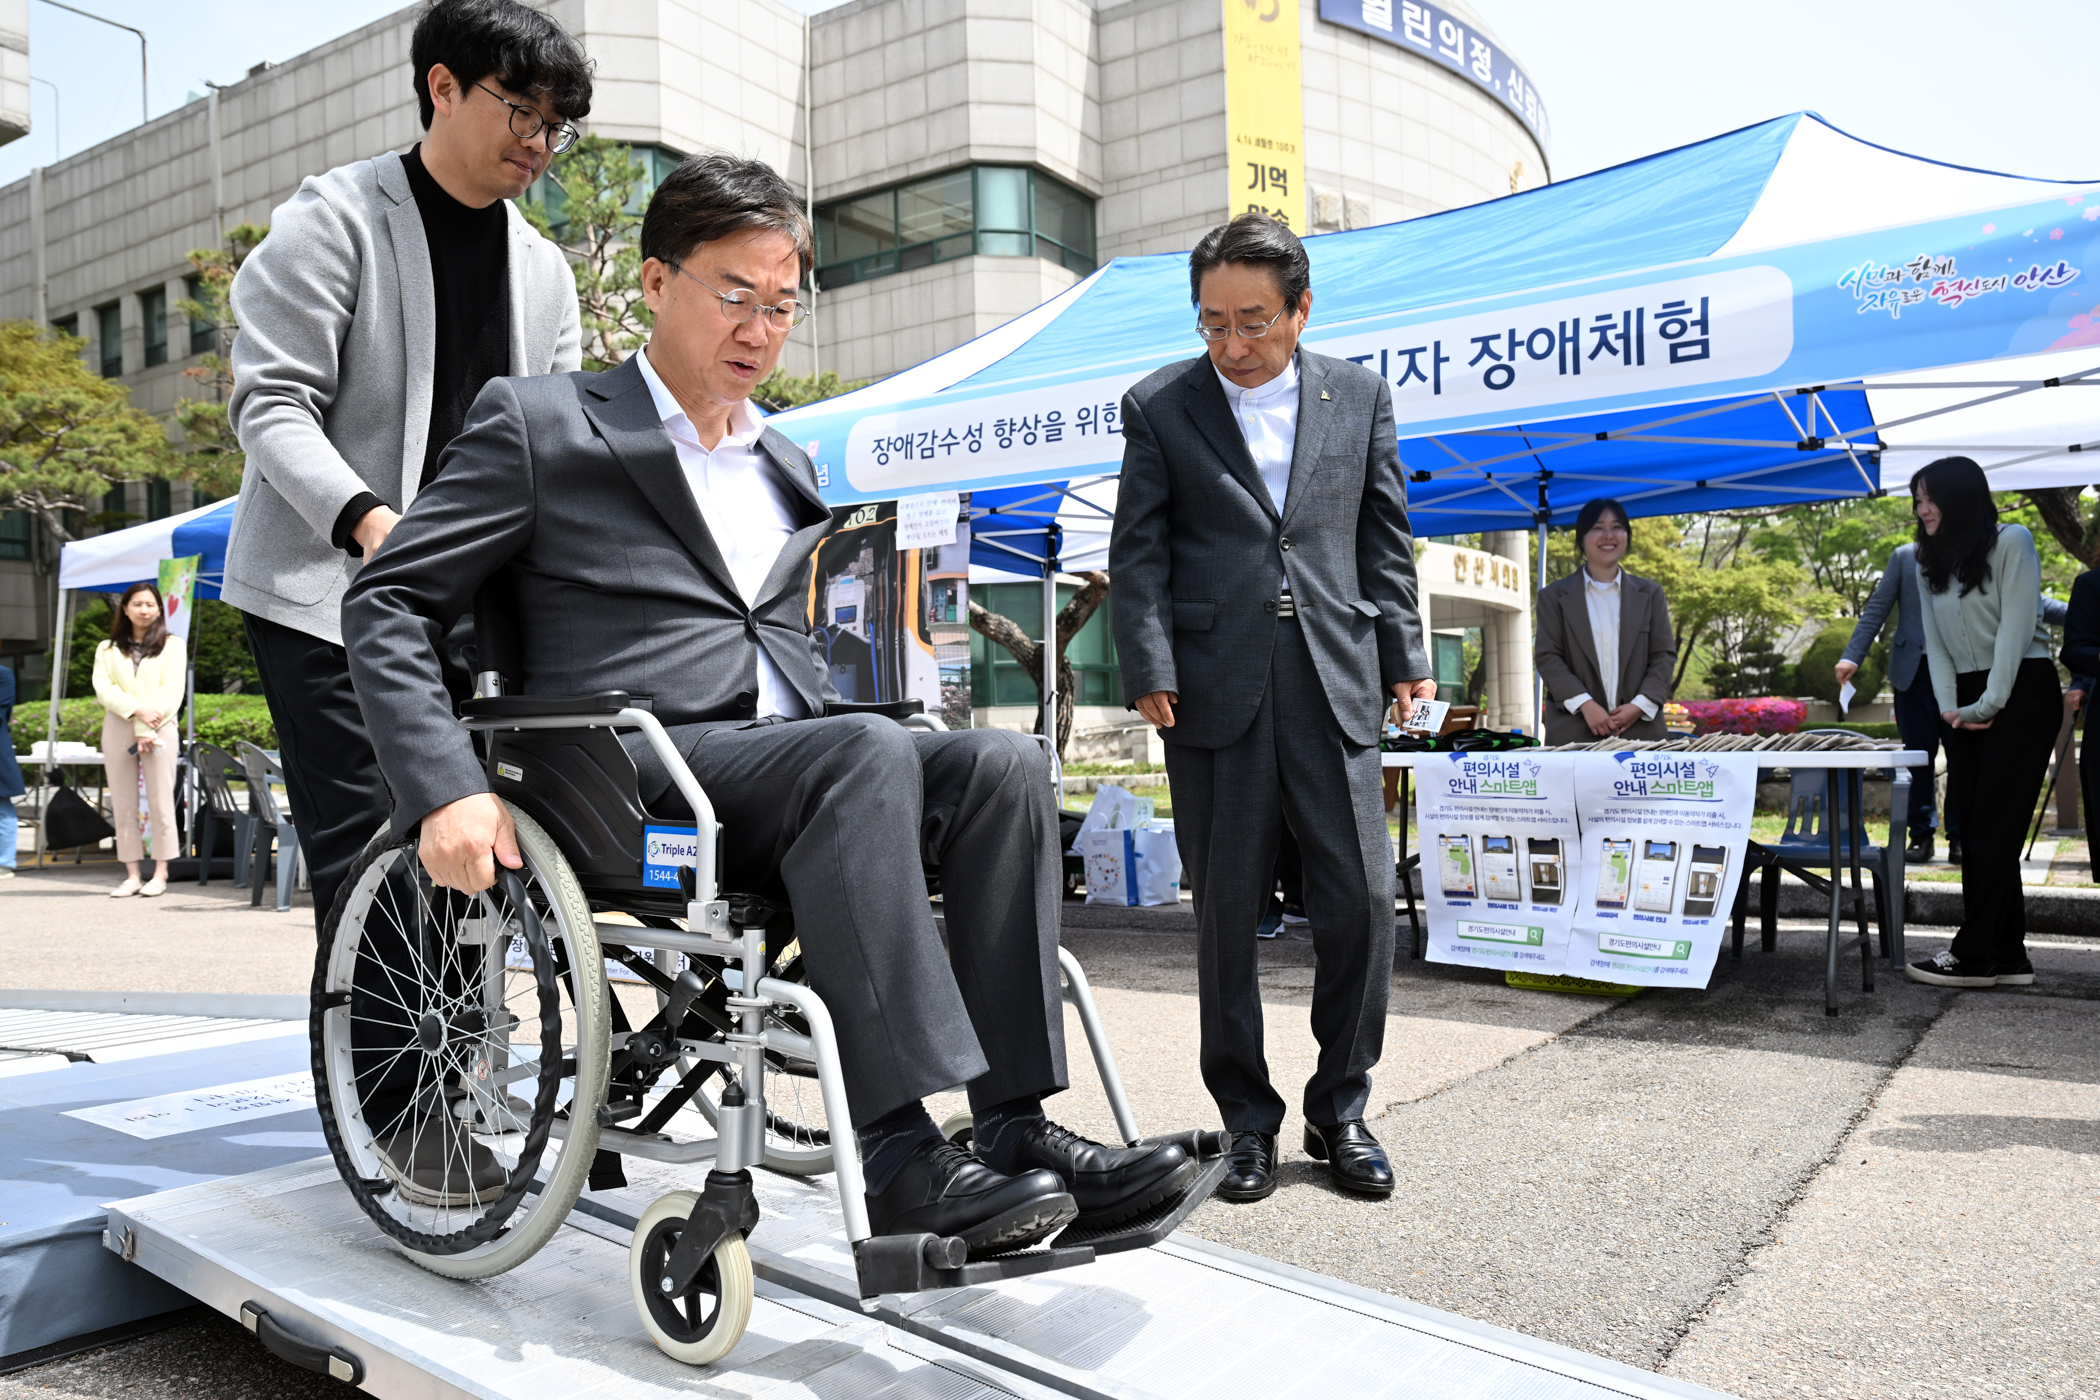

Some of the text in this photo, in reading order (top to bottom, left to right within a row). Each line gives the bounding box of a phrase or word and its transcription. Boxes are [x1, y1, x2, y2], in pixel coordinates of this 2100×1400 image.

[1247, 162, 1288, 196] 기억
[1838, 262, 1906, 298] 시민과
[1858, 262, 2079, 317] 자유로운 혁신도시 안산
[871, 422, 983, 466] 장애감수성
[993, 410, 1066, 449] 향상을
[1075, 402, 1124, 436] 위한
[1468, 296, 1711, 391] 장애체험
[1463, 761, 1520, 778] 편의시설
[1630, 761, 1696, 779] 편의시설
[1449, 778, 1537, 796] 안내 스마트앱
[1614, 779, 1713, 798] 안내 스마트앱
[661, 843, 685, 857] Triple
[1467, 925, 1516, 936] 경기도편의시설안내
[1608, 938, 1662, 951] 경기도편의시설안내
